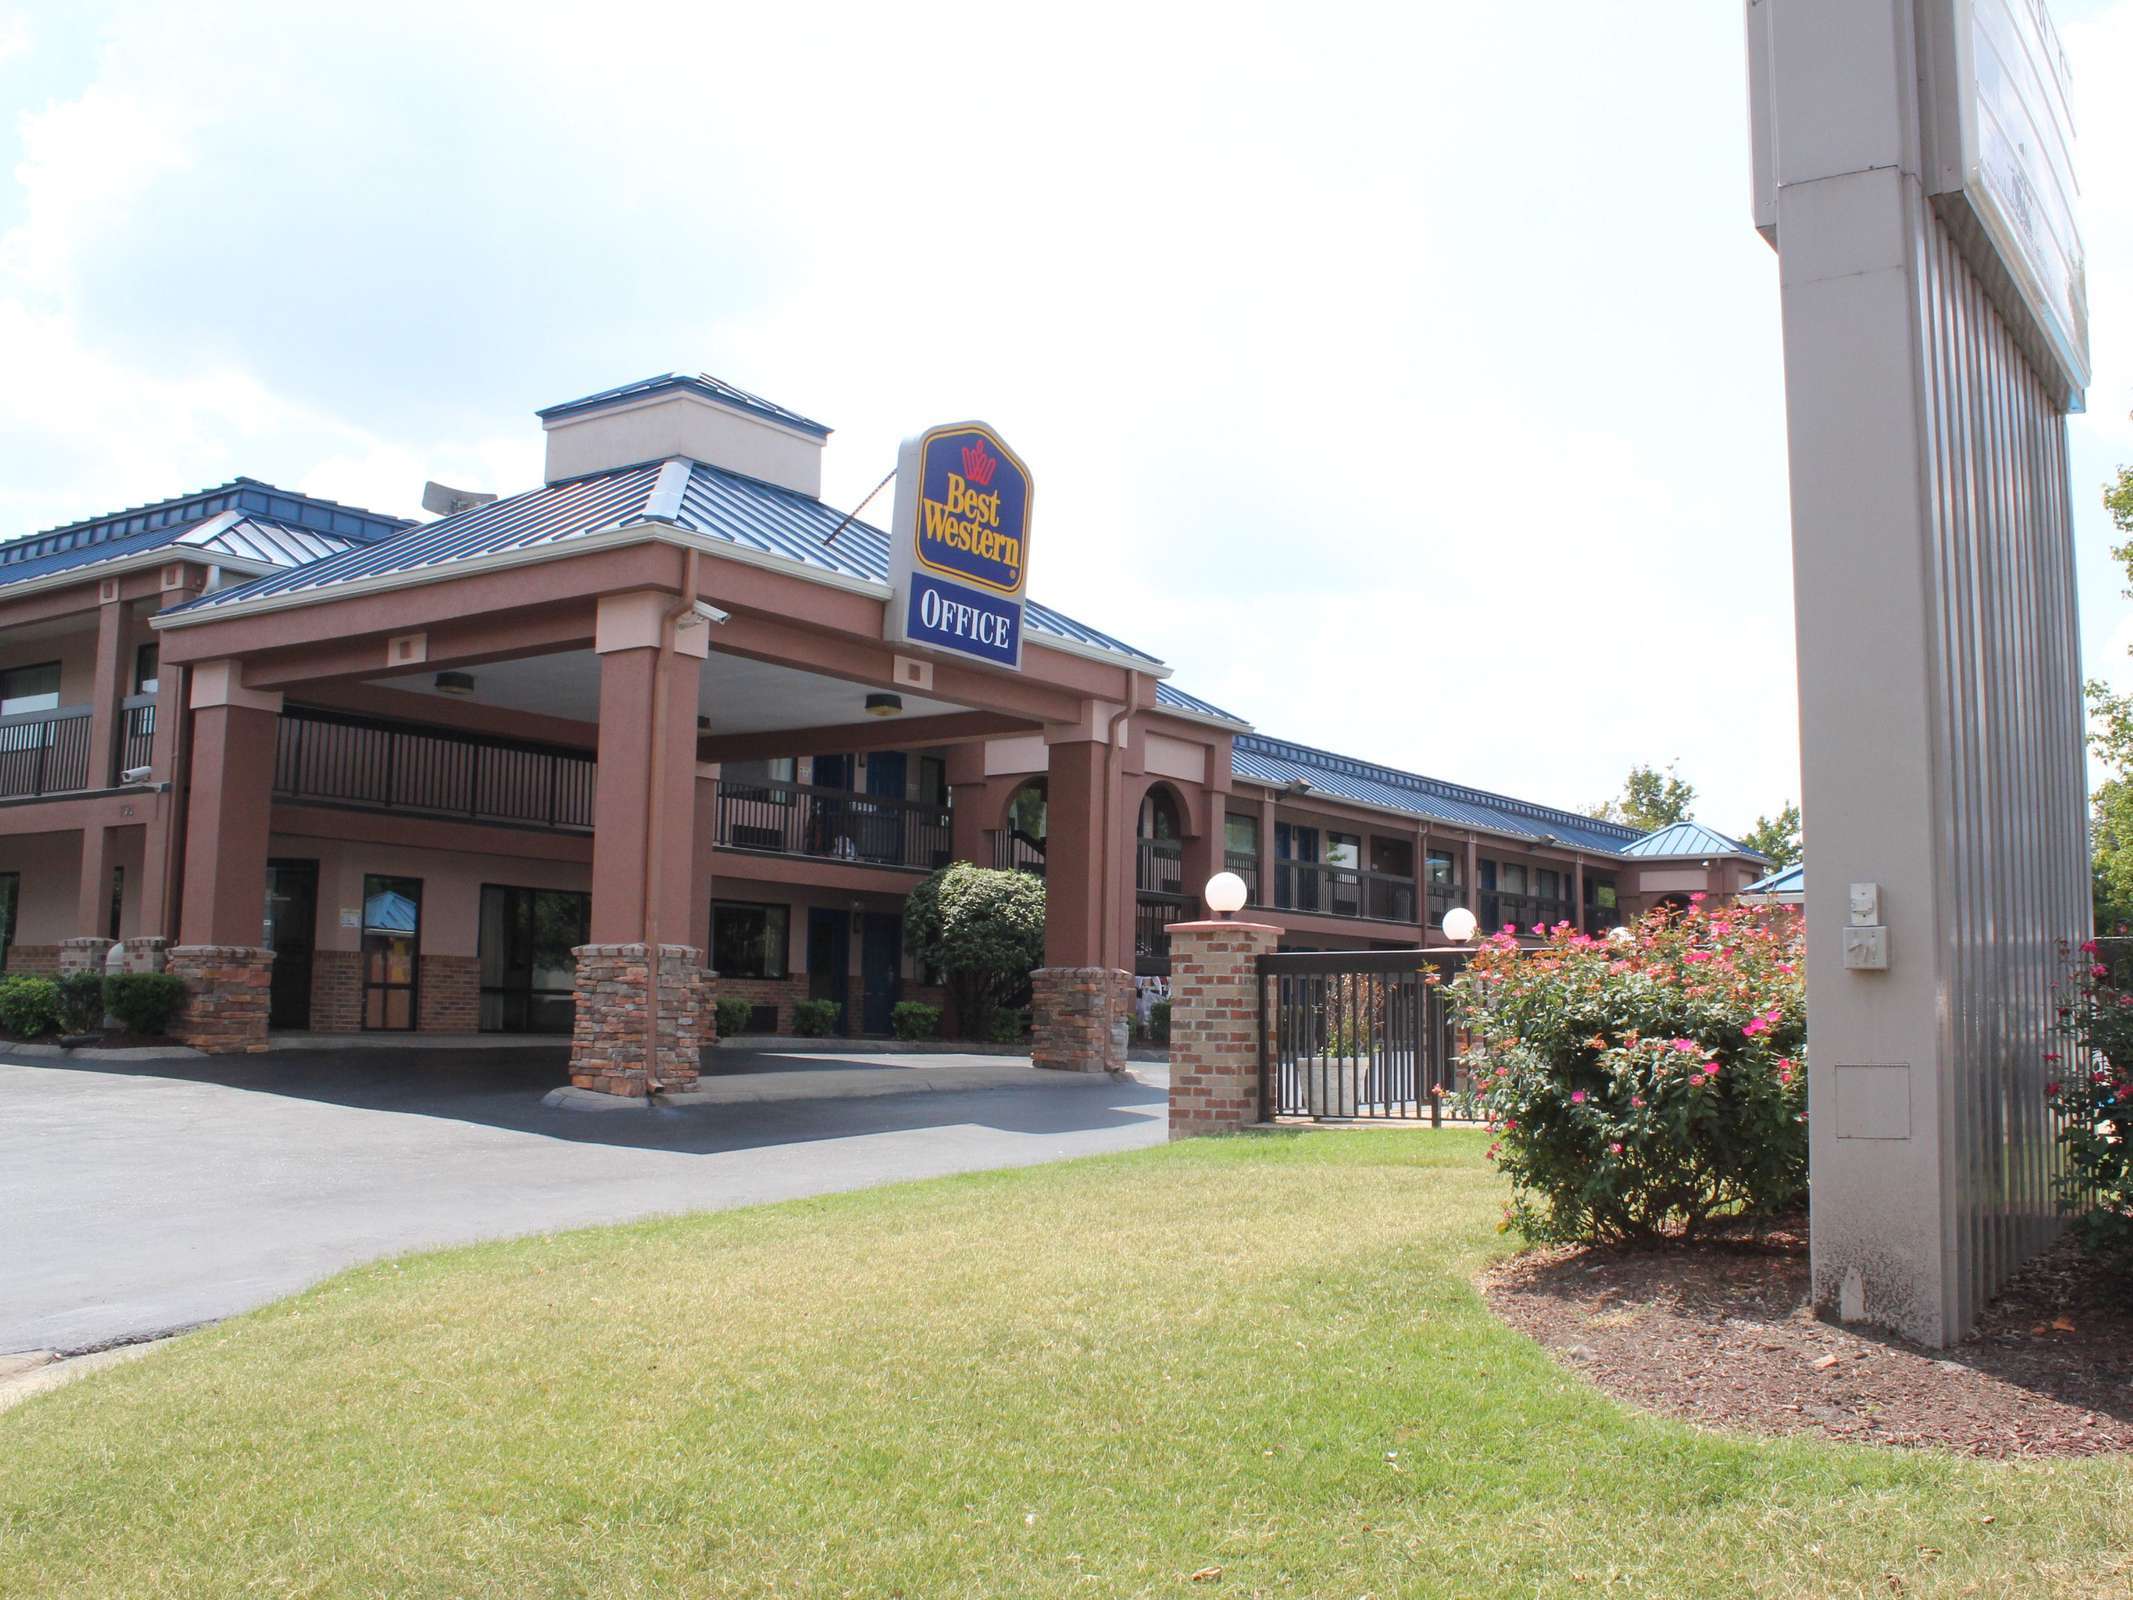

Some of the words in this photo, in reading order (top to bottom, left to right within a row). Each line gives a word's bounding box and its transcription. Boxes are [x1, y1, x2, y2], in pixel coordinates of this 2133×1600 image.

[948, 473, 1000, 527] Best
[923, 498, 1019, 568] Western
[921, 589, 1010, 649] OFFICE
